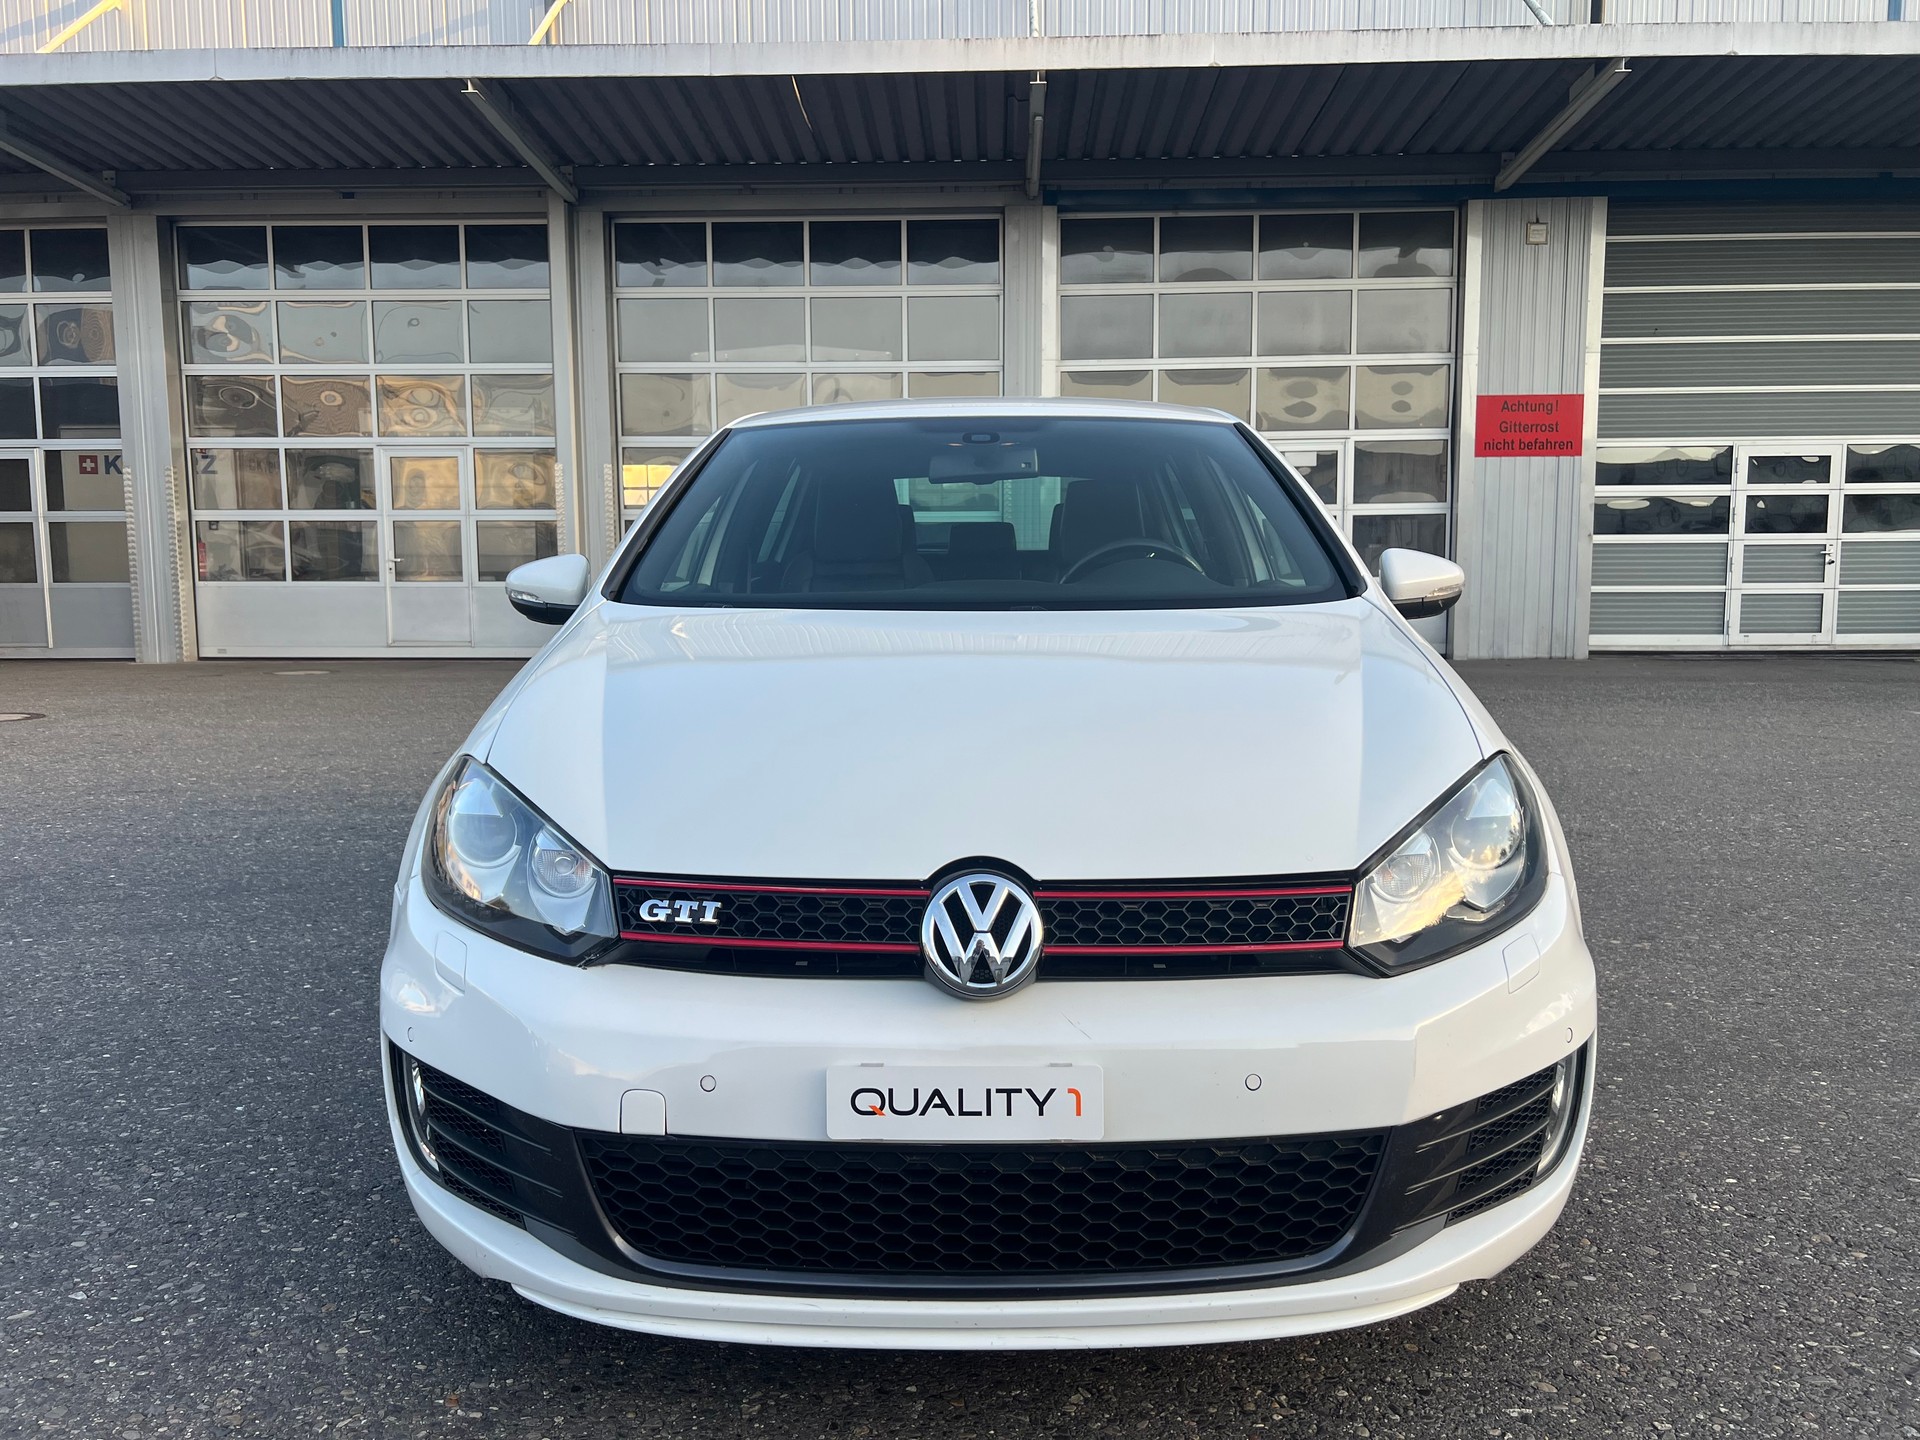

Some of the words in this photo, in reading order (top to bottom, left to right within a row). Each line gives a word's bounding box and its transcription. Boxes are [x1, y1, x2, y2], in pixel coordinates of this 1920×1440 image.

[1501, 400, 1559, 415] Achtung!
[1499, 421, 1560, 433] Gitterrost
[1483, 439, 1515, 451] nicht
[1518, 438, 1573, 450] befahren
[639, 899, 722, 924] GTI
[924, 875, 1042, 994] VW
[850, 1088, 1057, 1117] QUALITY
[1067, 1088, 1082, 1117] 1
